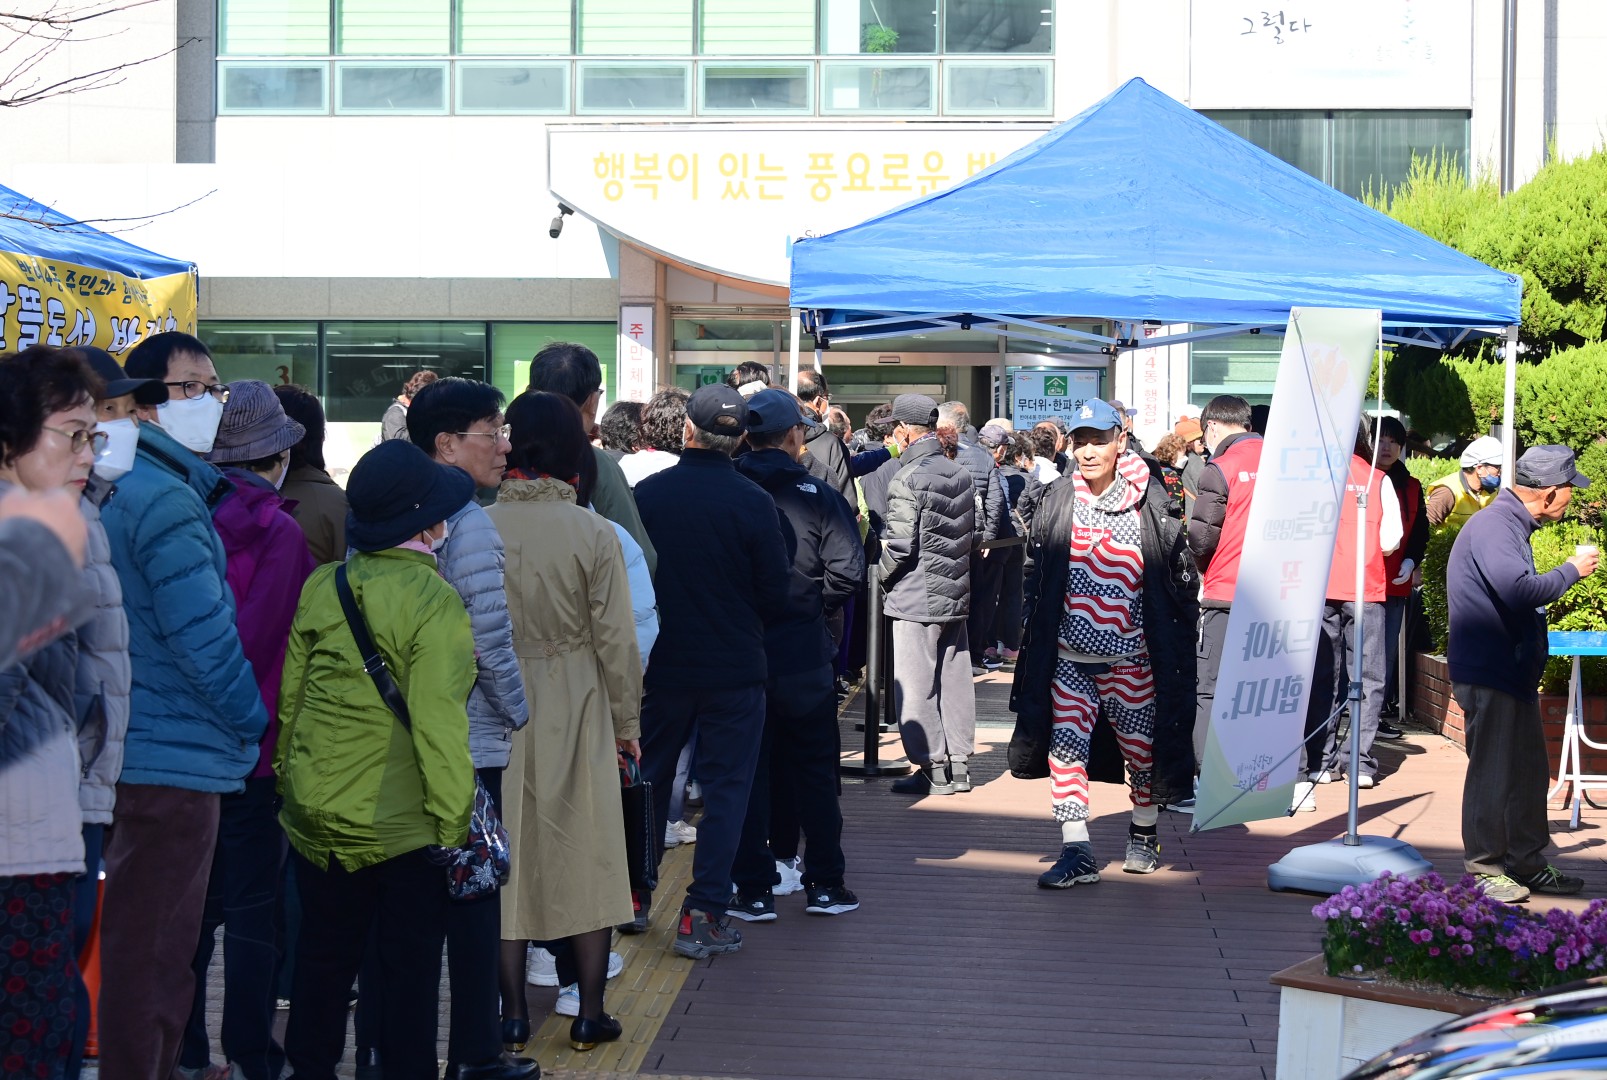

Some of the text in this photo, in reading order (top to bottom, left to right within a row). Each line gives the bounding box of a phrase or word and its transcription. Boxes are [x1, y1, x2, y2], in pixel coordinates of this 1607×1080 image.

[593, 151, 699, 202] 행복이
[718, 151, 788, 201] 있는
[804, 151, 950, 202] 풍요로운
[65, 269, 117, 297] 주민과
